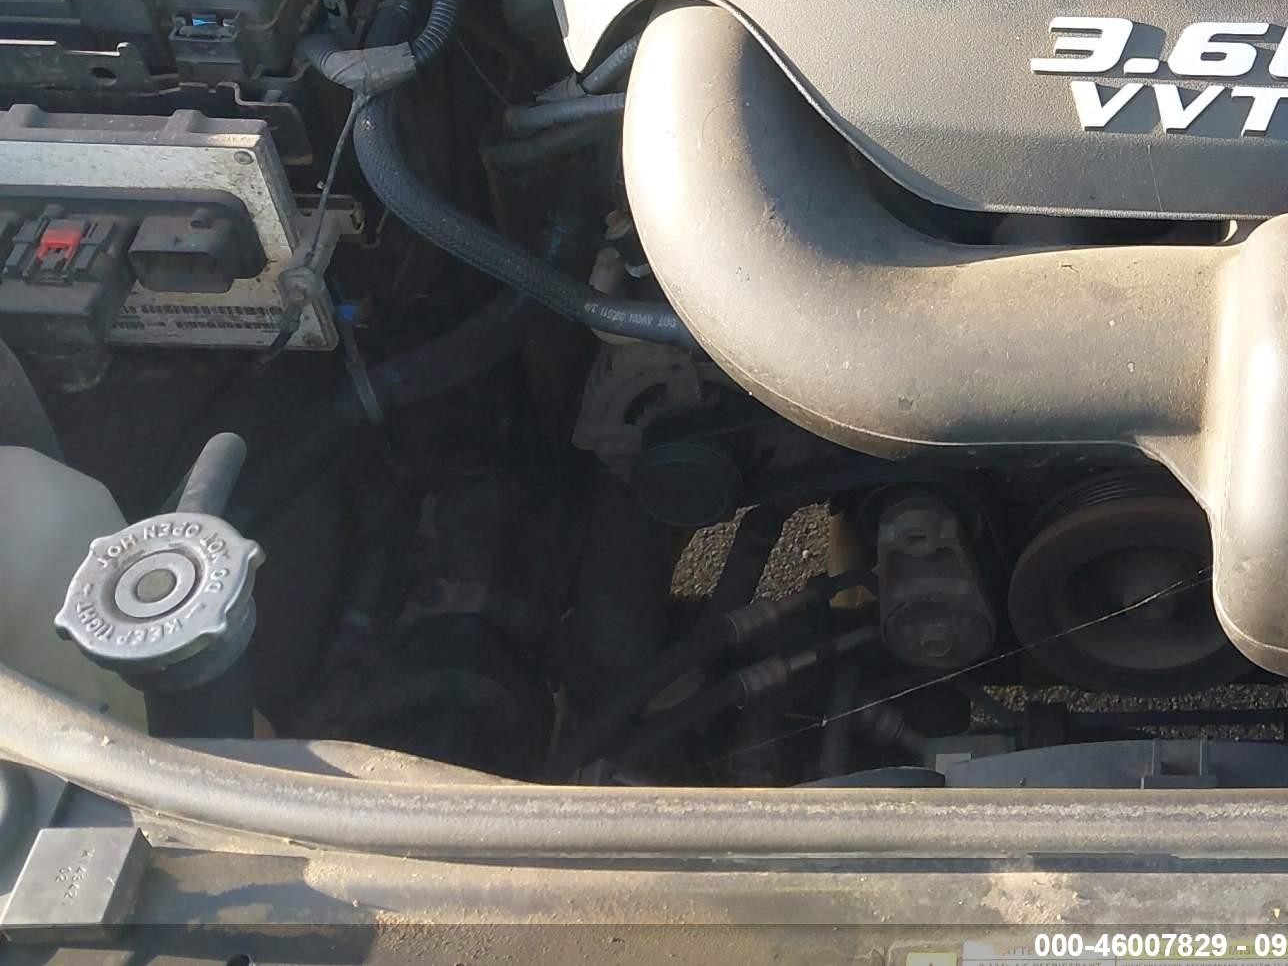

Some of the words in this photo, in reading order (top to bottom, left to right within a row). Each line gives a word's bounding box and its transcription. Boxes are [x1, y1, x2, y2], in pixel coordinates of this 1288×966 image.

[143, 521, 202, 541] OPEN
[96, 534, 139, 569] HOT
[199, 533, 232, 564] NOT
[204, 568, 231, 594] DO
[76, 602, 116, 641] TIGHT
[116, 618, 184, 646] KEEP
